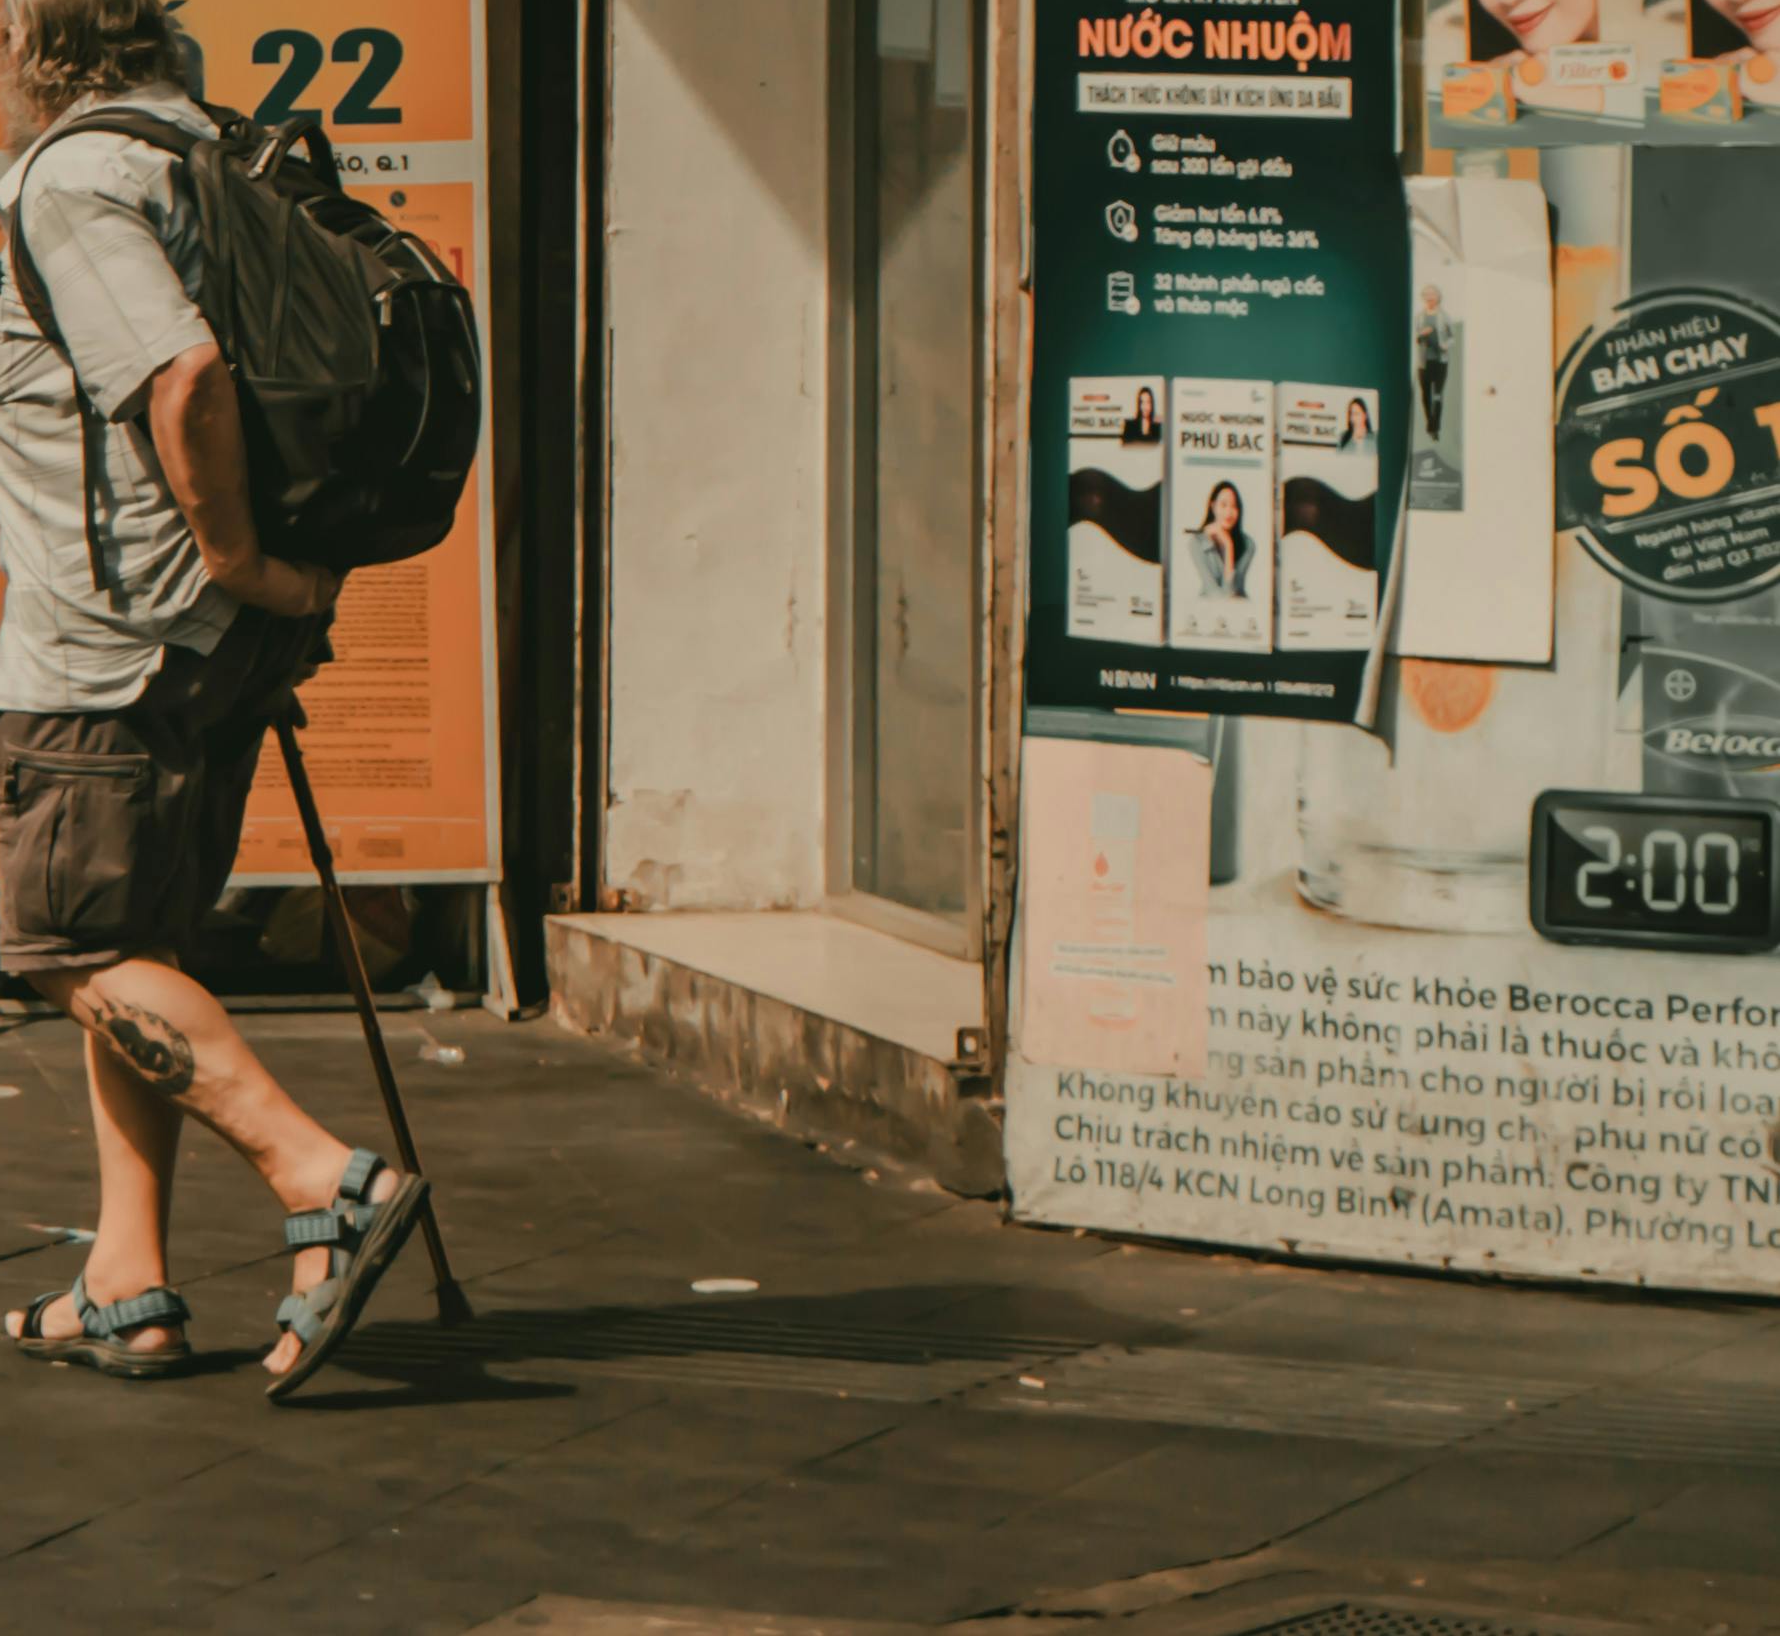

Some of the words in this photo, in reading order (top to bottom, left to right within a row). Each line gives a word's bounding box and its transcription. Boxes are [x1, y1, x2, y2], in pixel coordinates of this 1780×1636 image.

[1078, 7, 1195, 60] NƯỚC
[1204, 9, 1352, 73] NHUỘM
[251, 27, 405, 126] 22
[376, 153, 411, 174] Q.1
[1180, 156, 1209, 176] 300
[1153, 272, 1174, 292] 32
[1153, 294, 1176, 314] và
[1590, 354, 1661, 395] BÁN
[1664, 332, 1749, 377] CHẠY
[1590, 385, 1736, 518] SỐ
[1729, 526, 1770, 546] Nam
[1576, 826, 1740, 915] 2:00
[1237, 958, 1295, 992] bảo
[1303, 966, 1339, 1006] vệ
[1346, 971, 1401, 1002] sức
[1507, 984, 1655, 1021] Berocca
[1237, 1003, 1292, 1042] này
[1301, 1008, 1402, 1057] không
[1414, 1018, 1489, 1056] phải
[1500, 1025, 1530, 1055] là
[1541, 1026, 1649, 1064] thuốc
[1658, 1036, 1701, 1068] và
[1253, 1046, 1308, 1081] sản
[1316, 1049, 1410, 1090] phẩm
[1420, 1063, 1485, 1096] cho
[1612, 1075, 1647, 1118] bị
[1658, 1075, 1707, 1112] rối
[1056, 1070, 1156, 1113] Không
[1287, 1094, 1342, 1126] cáo
[1350, 1099, 1388, 1131] sử
[1573, 1120, 1647, 1161] phụ
[1658, 1125, 1709, 1156] nữ
[1718, 1129, 1764, 1159] có
[1054, 1114, 1122, 1152] Chịu
[1132, 1120, 1211, 1157] trách
[1219, 1130, 1322, 1171] nhiệm
[1372, 1146, 1431, 1180] sản
[1566, 1161, 1661, 1205] Công
[1674, 1172, 1710, 1206] ty
[1053, 1155, 1087, 1185] Lô
[1094, 1158, 1164, 1196] 118/4
[1174, 1165, 1240, 1200] KCN
[1249, 1175, 1326, 1218] Long
[1585, 1207, 1736, 1253] Phường
